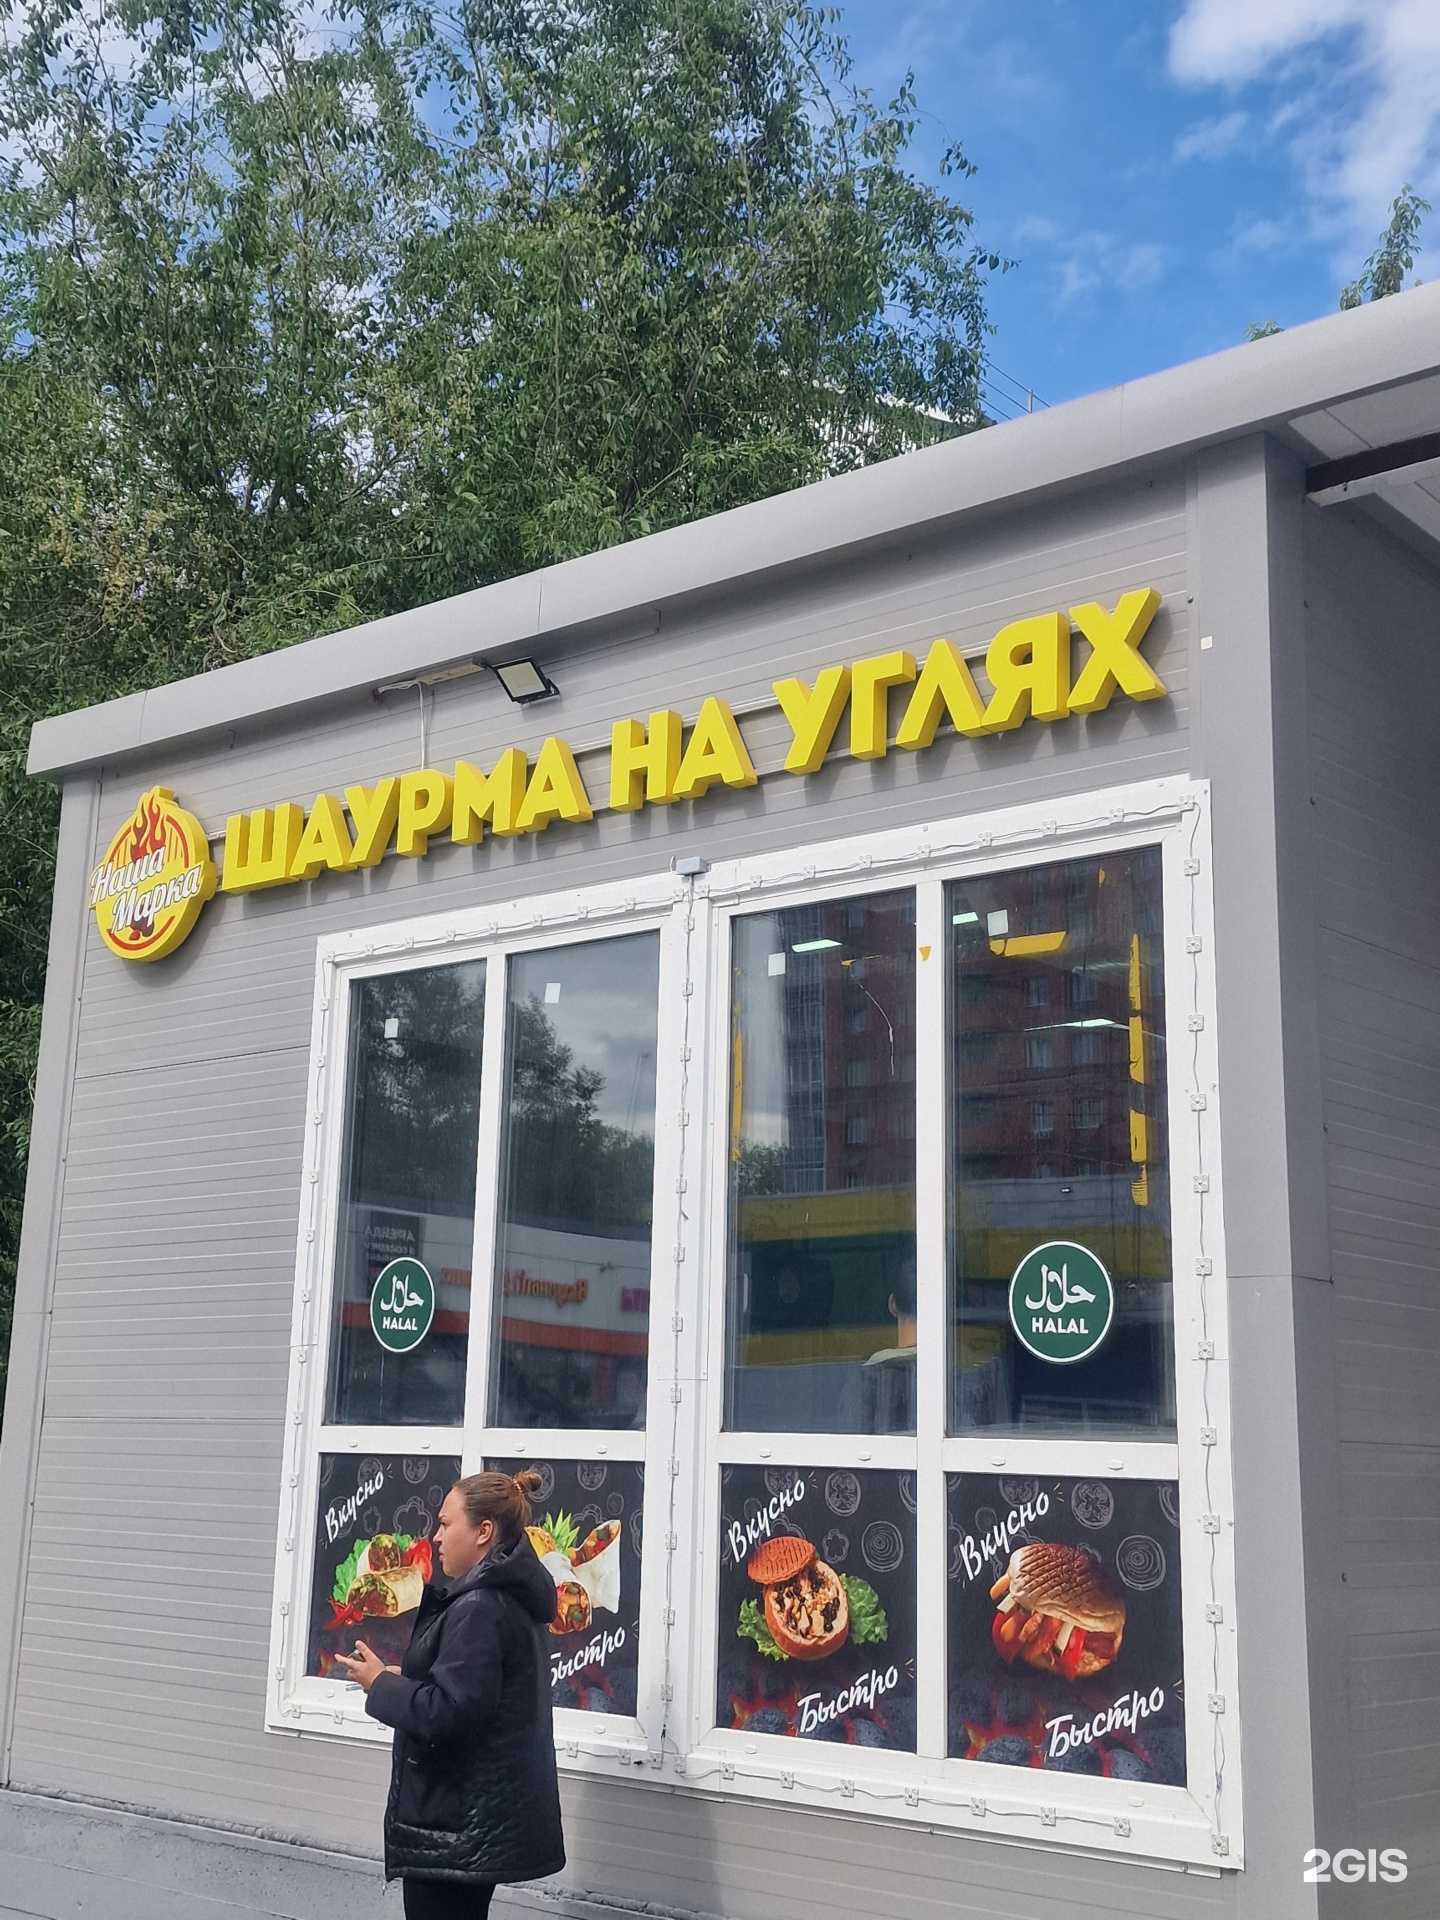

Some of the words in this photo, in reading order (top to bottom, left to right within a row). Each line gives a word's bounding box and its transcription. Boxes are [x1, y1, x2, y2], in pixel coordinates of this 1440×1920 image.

[221, 738, 592, 893] ШАУРМА
[610, 697, 758, 811] НА
[773, 587, 1167, 774] УГЛЯХ
[90, 846, 166, 905] Наша
[112, 864, 202, 935] Марка
[380, 1274, 424, 1313] حلال
[1025, 1262, 1096, 1313] حلال
[382, 1317, 418, 1331] HALAL
[1031, 1317, 1089, 1335] HALAL
[323, 1471, 385, 1544] Вкусно
[727, 1477, 806, 1563] Вкусно
[958, 1490, 1050, 1581] Вкусно
[797, 1664, 898, 1733] Быстро
[1045, 1685, 1165, 1757] Быстро
